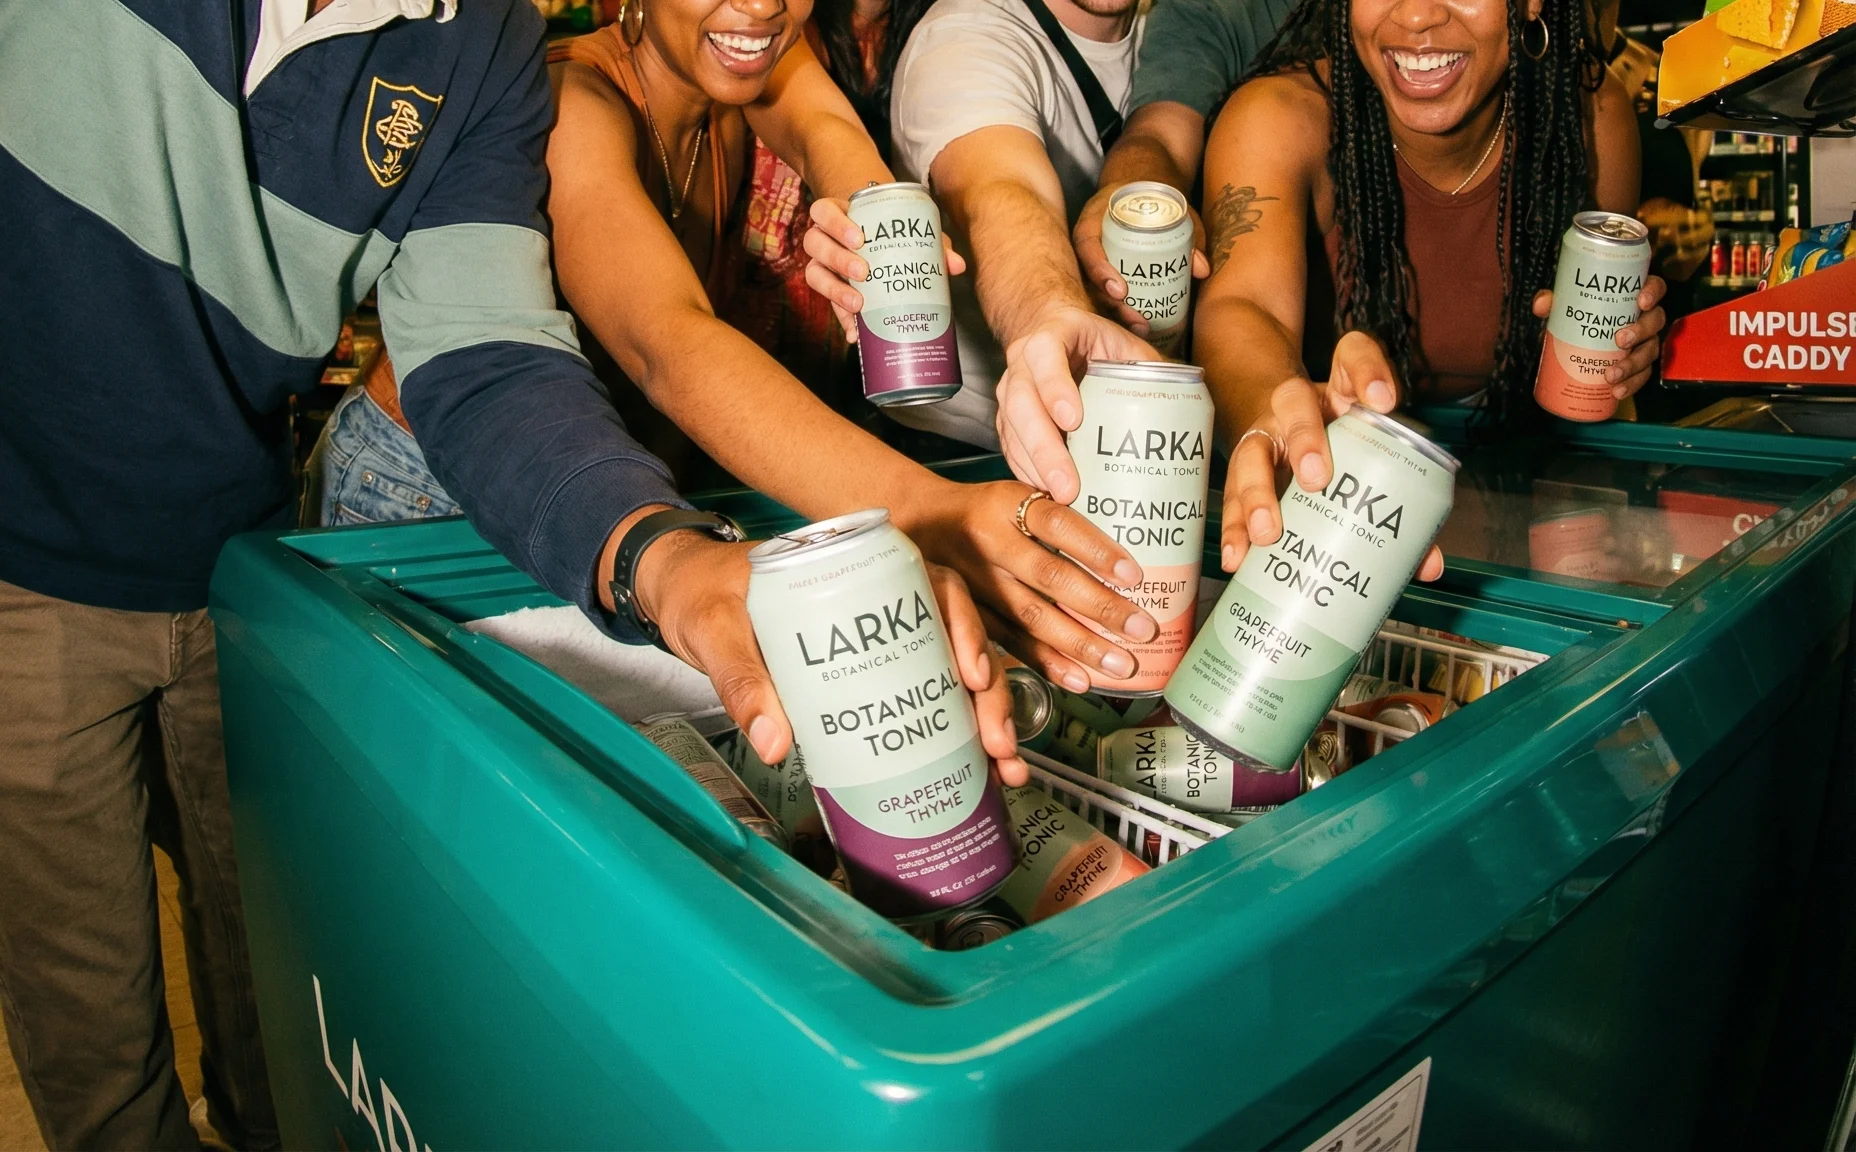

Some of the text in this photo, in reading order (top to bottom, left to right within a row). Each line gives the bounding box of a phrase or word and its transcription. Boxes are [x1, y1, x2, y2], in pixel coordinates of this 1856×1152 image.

[863, 218, 936, 244] LARKA
[1120, 254, 1188, 279] LARKA
[1575, 268, 1642, 294] LARKA
[883, 278, 932, 293] TONIC
[1580, 325, 1614, 340] TONI
[1743, 344, 1851, 371] CADDY
[1097, 425, 1205, 461] LARKA
[1104, 463, 1168, 476] BOTANICAL
[1087, 495, 1203, 521] BOTANICAL
[1321, 472, 1403, 539] RKA
[1112, 524, 1185, 547] TONIC
[1351, 524, 1385, 548] TONIC
[1263, 554, 1334, 607] TONIC
[1277, 529, 1371, 598] TANICAL
[796, 590, 932, 666] LARKA
[1229, 602, 1311, 658] GRAPEFRUIT
[1233, 626, 1283, 664] THYME
[821, 631, 935, 682] BOTANICAL TONIC
[820, 667, 959, 735] BOTANICAL
[863, 708, 949, 756] TONIC
[878, 763, 973, 813] GRAPEFRUIT
[905, 790, 963, 824] THYME
